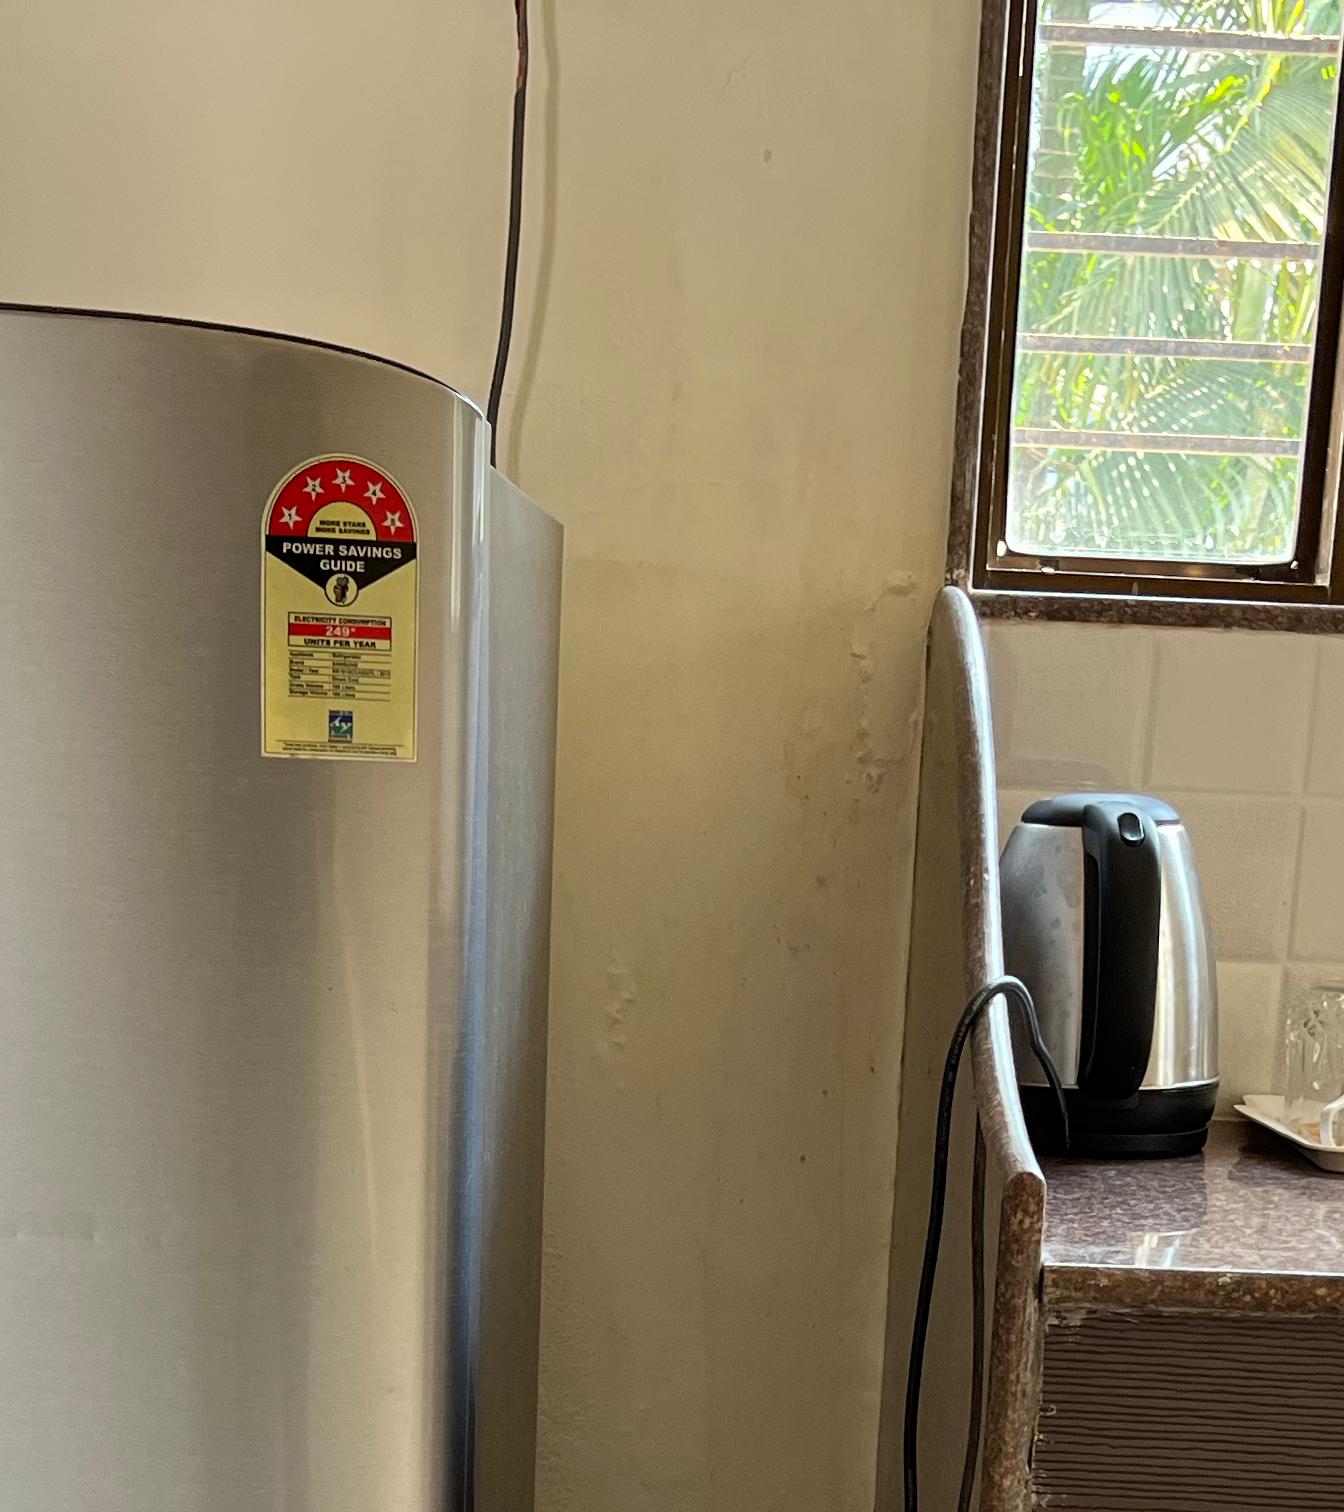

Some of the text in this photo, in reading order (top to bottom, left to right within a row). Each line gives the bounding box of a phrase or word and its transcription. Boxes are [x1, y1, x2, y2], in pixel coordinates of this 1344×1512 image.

[282, 542, 402, 559] POWER SAVINGS
[319, 559, 365, 572] GUIDE
[303, 638, 376, 648] UNITS PER YEAR
